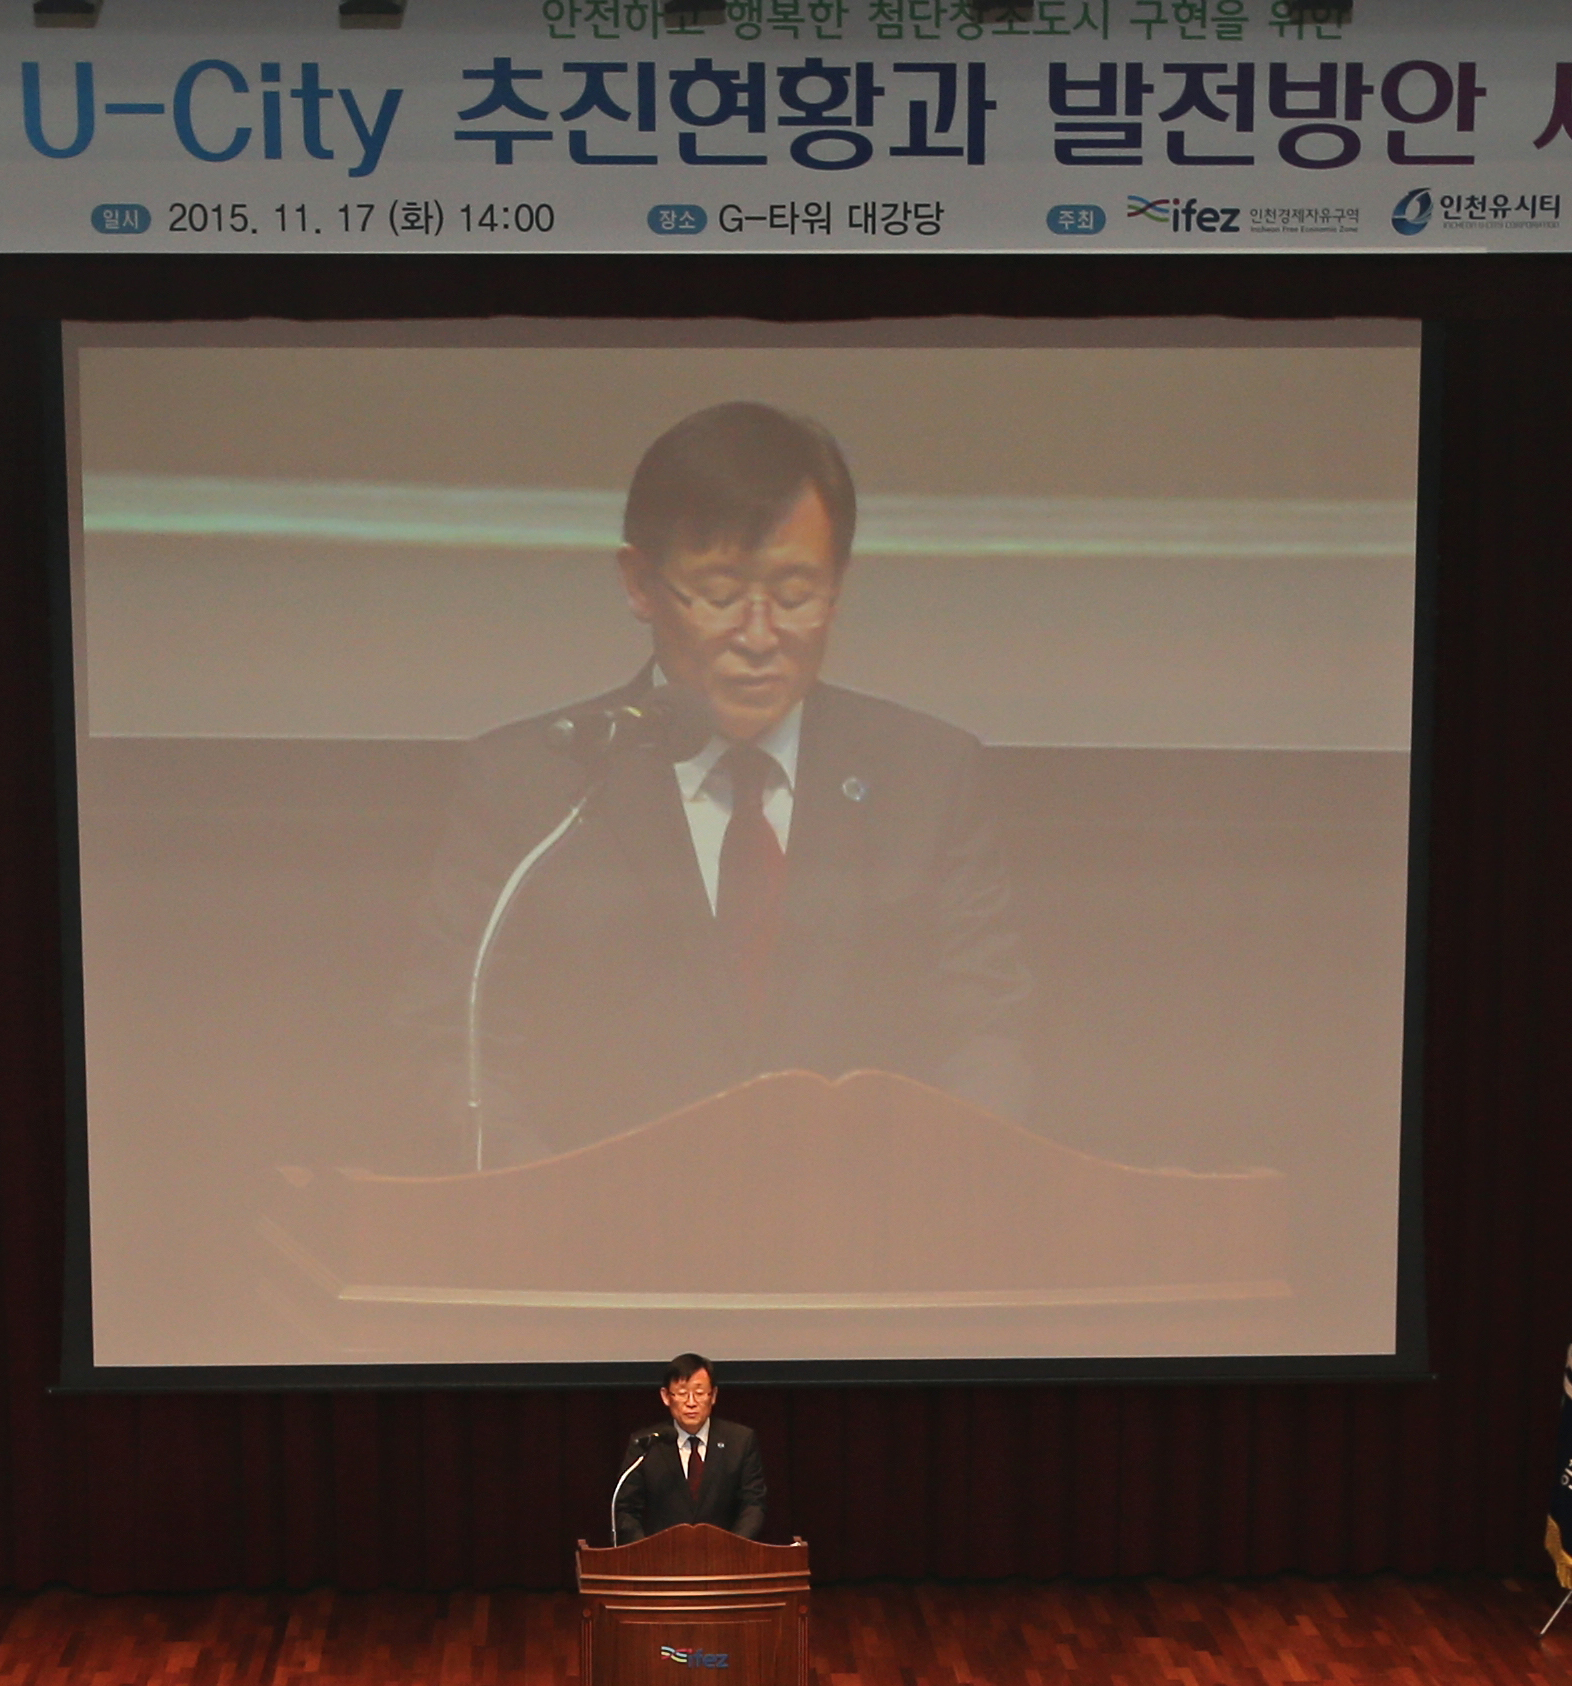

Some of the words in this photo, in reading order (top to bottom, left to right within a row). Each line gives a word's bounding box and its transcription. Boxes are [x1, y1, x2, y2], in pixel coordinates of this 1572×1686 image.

[729, 0, 849, 40] 행복한
[1130, 0, 1249, 40] 구현을
[21, 58, 404, 178] U-City
[454, 57, 997, 171] 추진현황과
[1048, 60, 1487, 170] 발전방안
[102, 209, 139, 230] 일시
[169, 203, 257, 234] 2015.
[275, 203, 321, 234] 11.
[338, 204, 374, 233] 17
[389, 200, 444, 237] (화)
[461, 203, 555, 233] 14:00
[658, 209, 697, 232] 장소
[719, 202, 833, 236] G-타워
[848, 201, 945, 236] 대강당
[1057, 210, 1096, 231] 주최
[1172, 198, 1241, 233] ifez
[1249, 208, 1360, 225] 인천경제자유구역
[1439, 194, 1561, 220] 인천유시티
[688, 1648, 730, 1669] ifez
